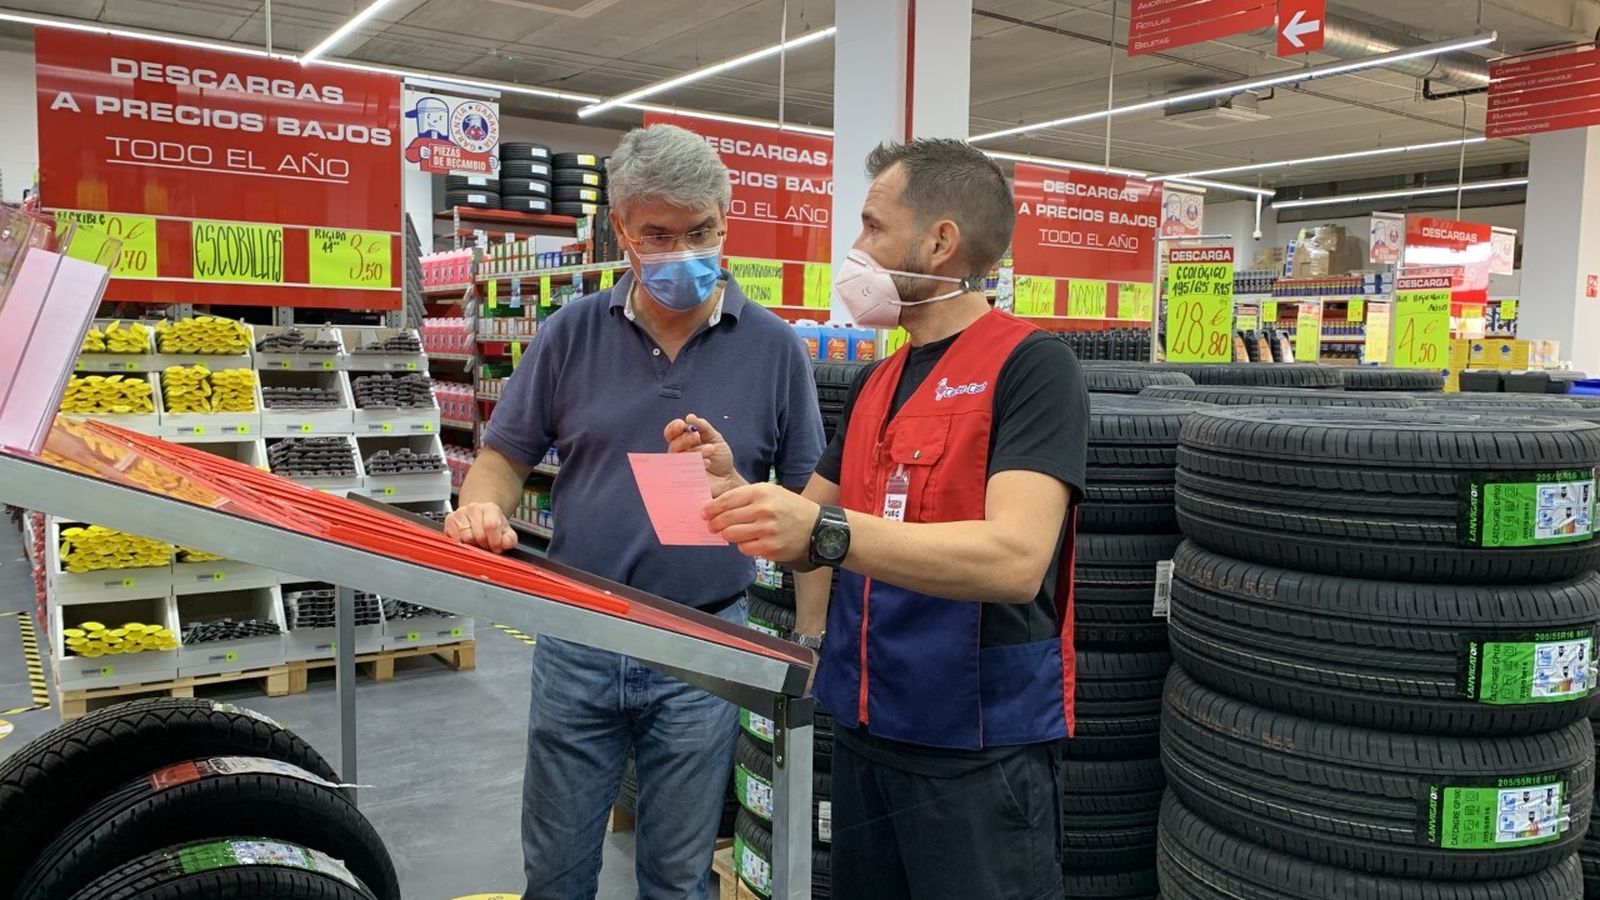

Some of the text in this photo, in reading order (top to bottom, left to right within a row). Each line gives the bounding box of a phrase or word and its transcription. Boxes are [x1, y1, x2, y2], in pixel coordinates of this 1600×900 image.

[110, 57, 345, 105] DESCARGAS
[50, 92, 392, 146] A PRECIOS BAJOS
[105, 136, 350, 178] TODO EL AÑO
[432, 145, 461, 158] PIEZAS
[432, 155, 487, 171] DE RECAMBIO
[703, 136, 829, 166] ESCARGAS
[727, 169, 779, 189] CIOS
[1043, 180, 1139, 202] DESCARGAS
[754, 202, 778, 218] EL
[784, 204, 829, 223] AÑO
[1018, 202, 1157, 228] A PRECIOS BAJOS
[1039, 228, 1139, 250] TODO EL AÑO
[1422, 227, 1478, 243] DESCARGAS
[195, 225, 282, 283] ESCOBILLAS
[1171, 250, 1232, 262] DESCARGA
[1398, 278, 1450, 288] DESCARGA
[1469, 483, 1479, 543] LANVIGATOR
[1467, 641, 1478, 700] LANVIGATOR
[1428, 786, 1439, 843] LANVIGATOR
